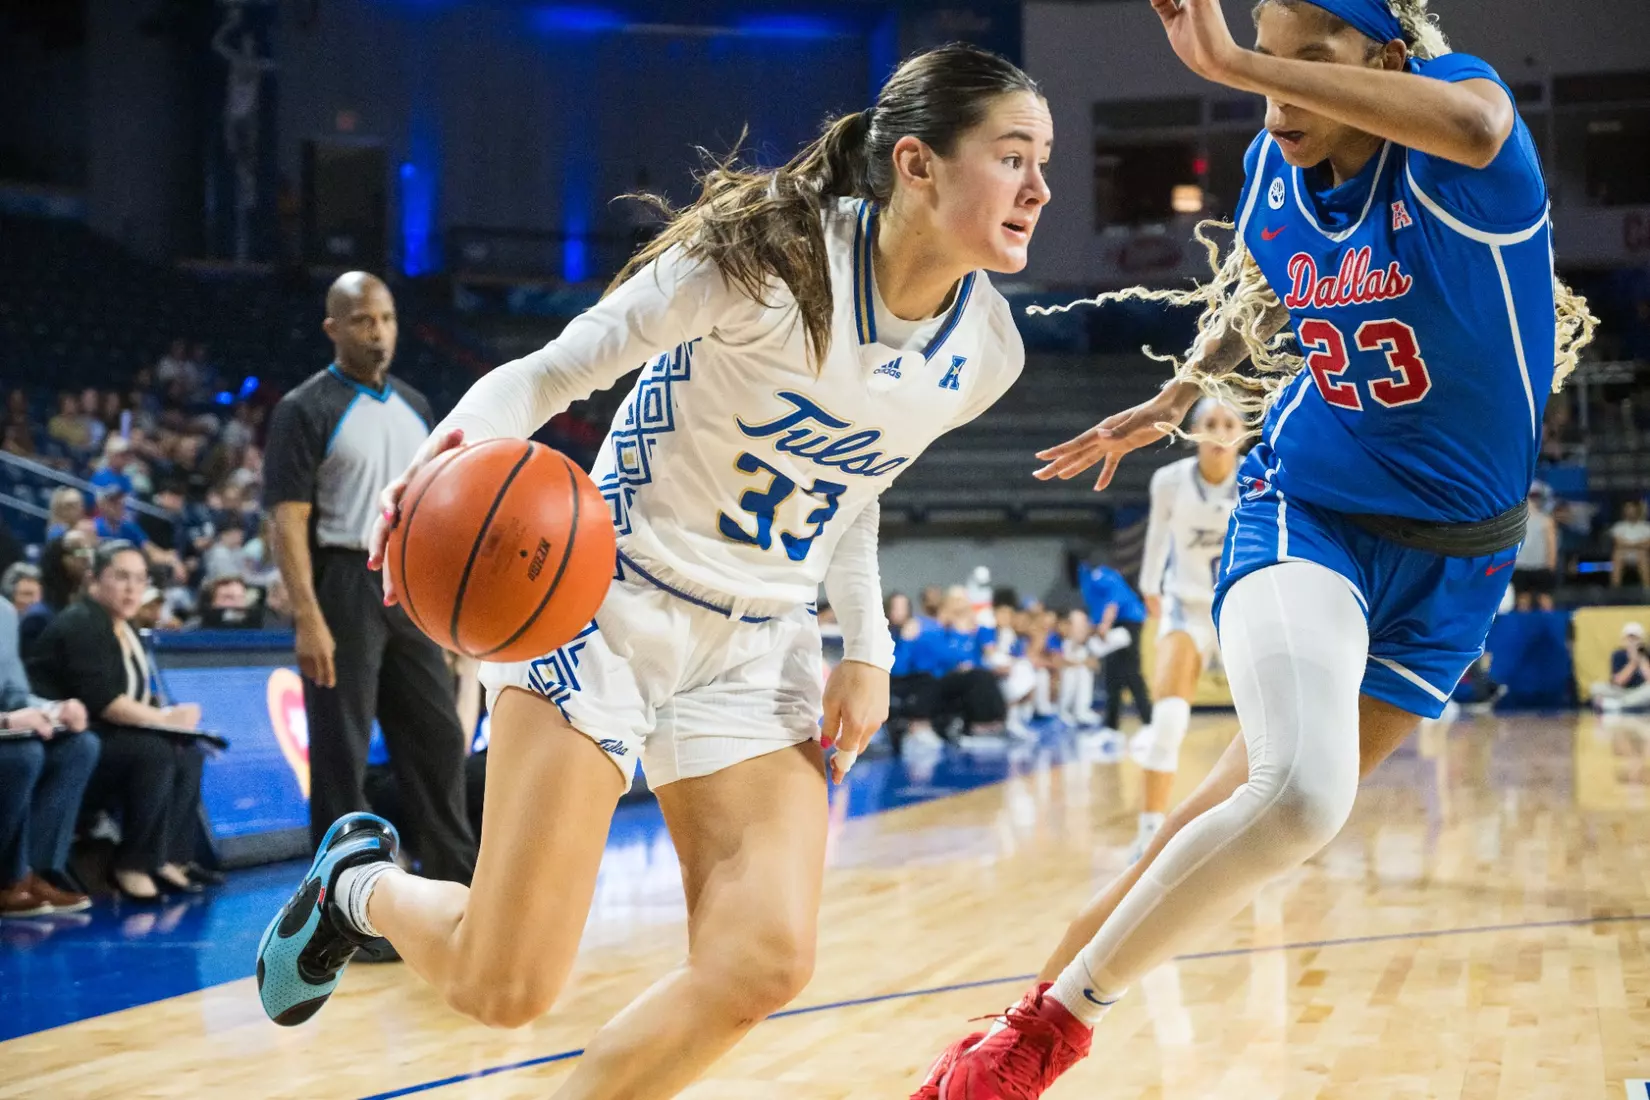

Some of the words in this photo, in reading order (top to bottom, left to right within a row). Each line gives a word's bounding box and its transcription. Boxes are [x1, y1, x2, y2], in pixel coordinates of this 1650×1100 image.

[1284, 245, 1413, 310] Dallas
[873, 366, 901, 379] adas
[1297, 318, 1432, 412] 23
[733, 387, 910, 477] Tulsa
[716, 450, 848, 563] 33
[599, 738, 629, 756] Tulsa
